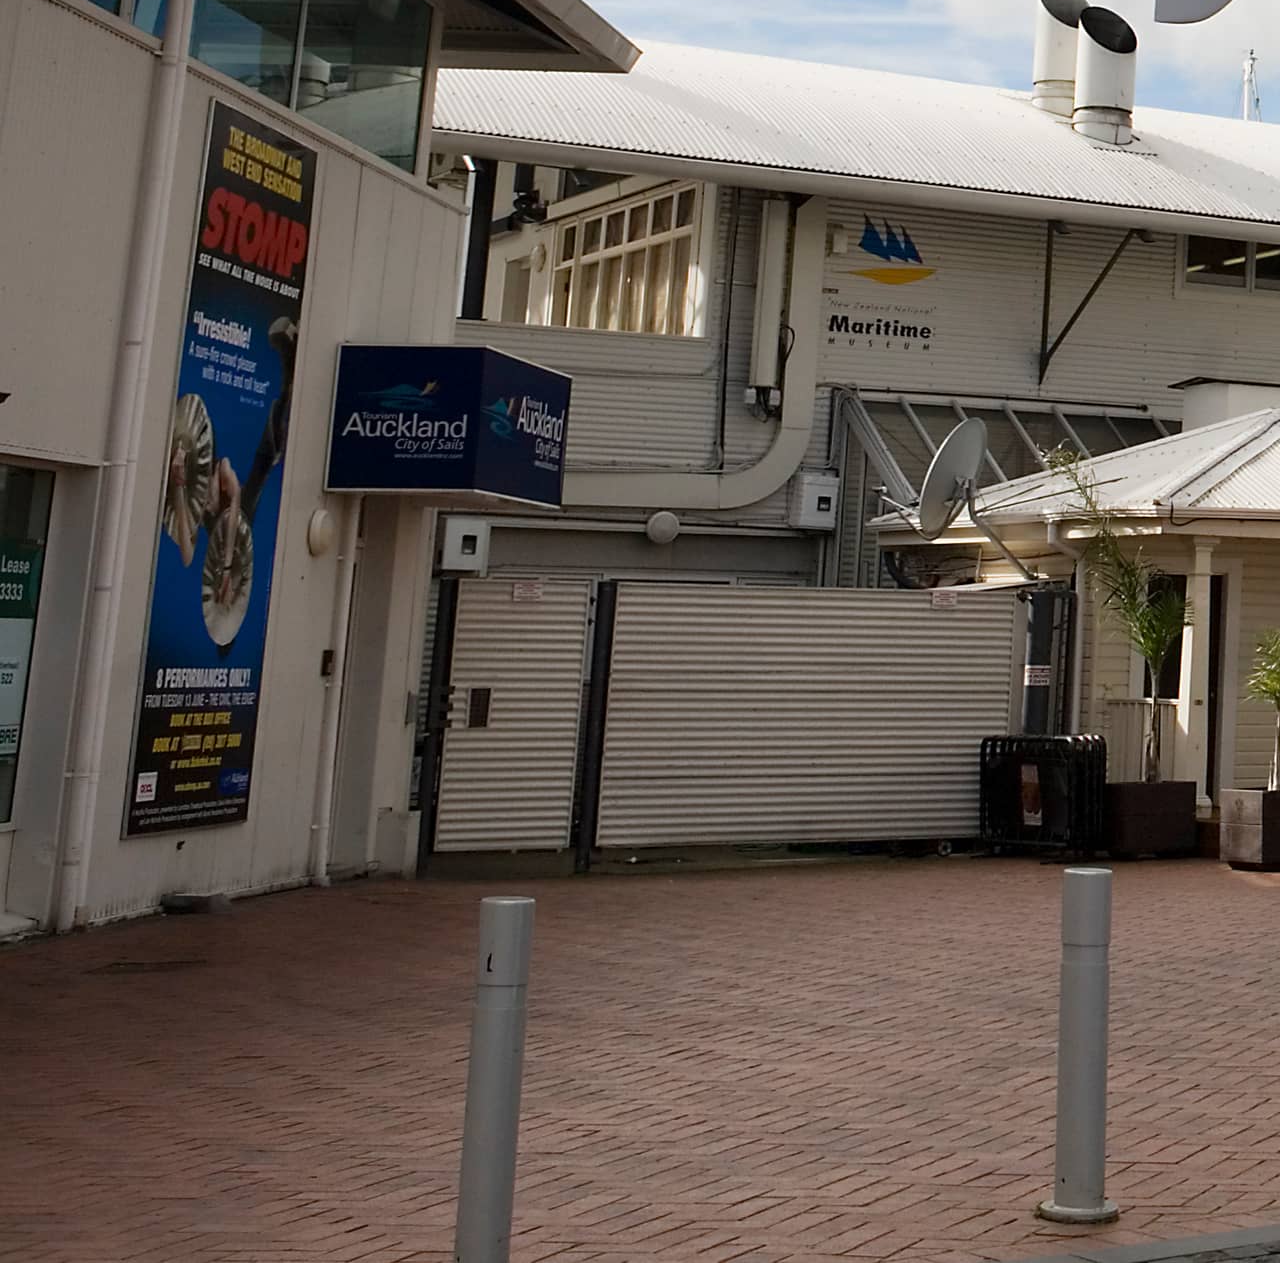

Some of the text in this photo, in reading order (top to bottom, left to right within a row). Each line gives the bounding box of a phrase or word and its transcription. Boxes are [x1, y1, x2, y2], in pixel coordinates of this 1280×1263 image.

[229, 125, 244, 152] THE
[223, 147, 246, 176] WEST
[247, 159, 263, 184] END
[202, 187, 307, 277] STOMP
[198, 252, 300, 300] SEE WHAT ALL THE NOISE IS ABOUT
[828, 314, 932, 339] Maritime
[827, 337, 930, 351] MUSEUM
[233, 374, 244, 388] and
[342, 412, 468, 438] Auckland
[361, 411, 398, 420] Tourism
[517, 396, 566, 443] Auckland
[394, 438, 464, 454] City of Sails
[535, 437, 546, 455] City
[550, 443, 561, 459] Sails
[1, 554, 30, 574] Lease
[156, 668, 251, 689] 8 PERFORMANCES ONLY!
[144, 693, 162, 708] FROM
[161, 693, 185, 707] TUESDAY
[191, 693, 204, 707] JUNE
[170, 713, 186, 727] BOOK
[152, 737, 171, 753] BOOK
